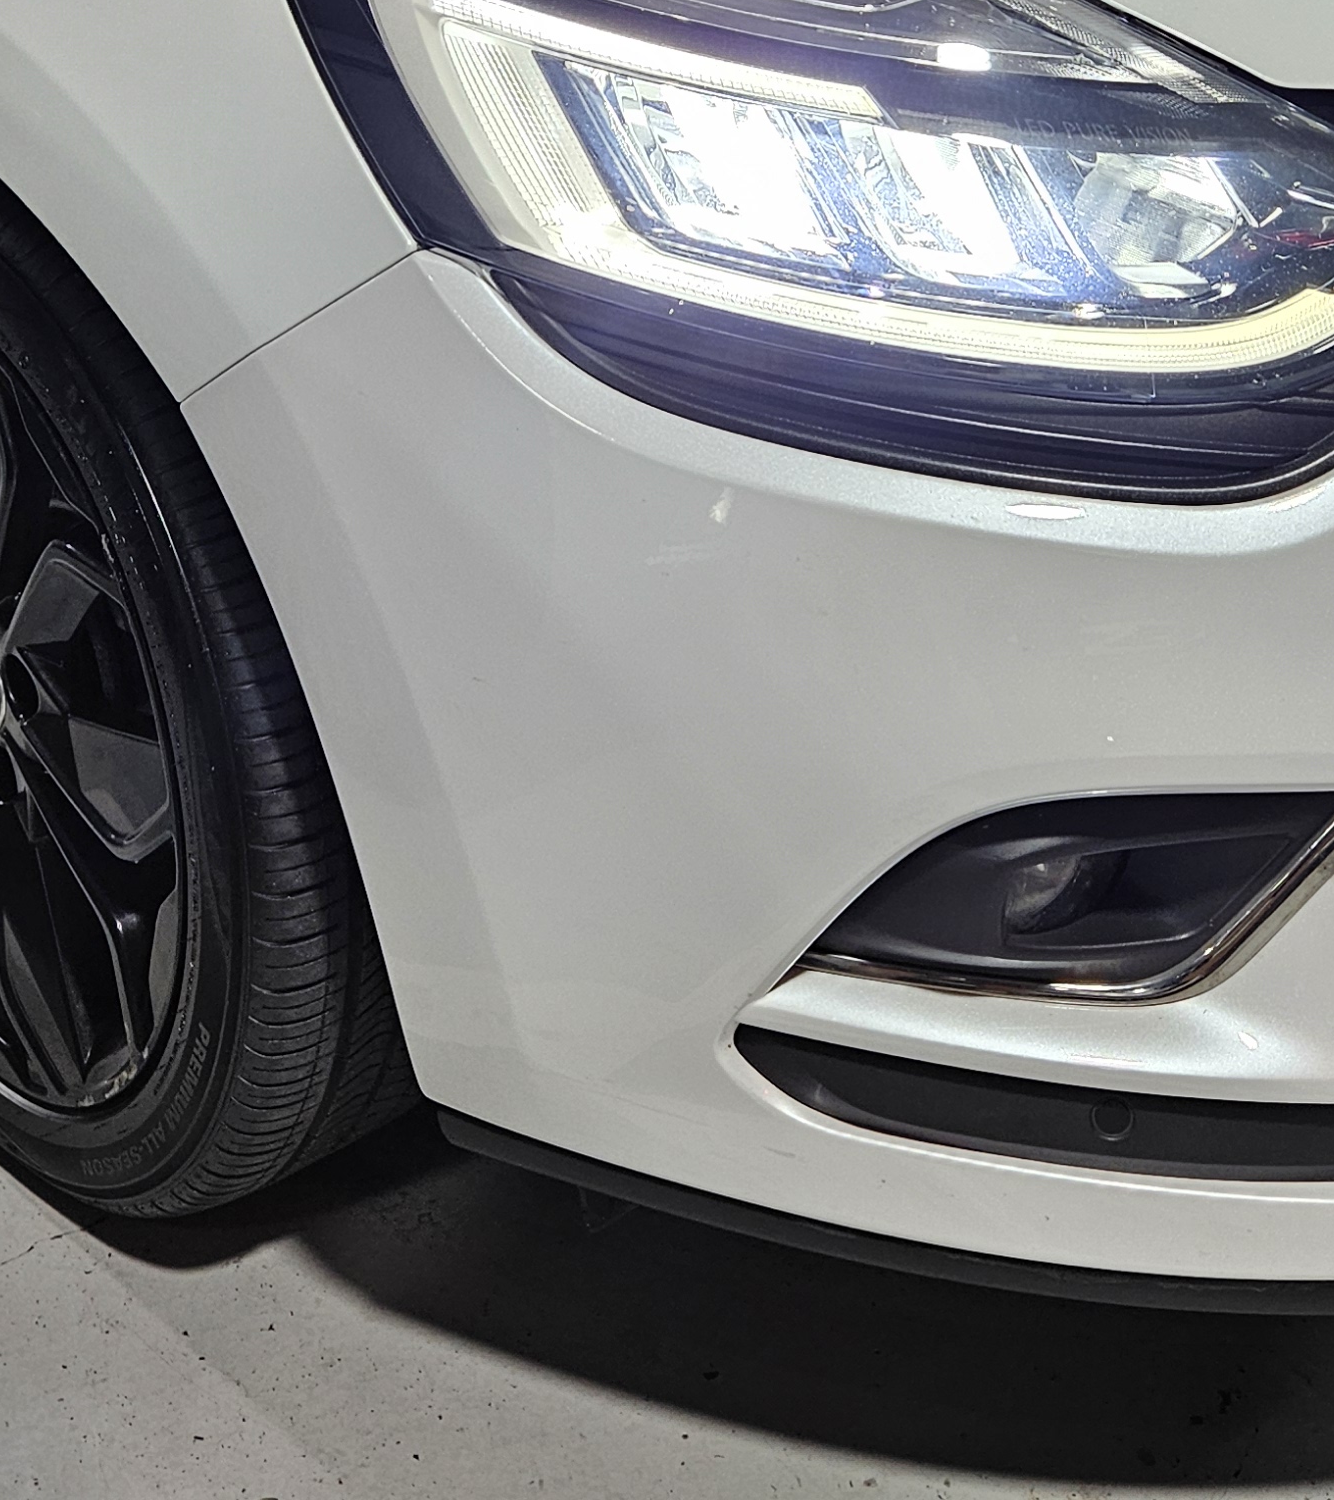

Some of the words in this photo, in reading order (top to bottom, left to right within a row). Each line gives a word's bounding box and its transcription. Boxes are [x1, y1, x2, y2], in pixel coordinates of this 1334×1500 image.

[1014, 117, 1056, 138] LED
[1062, 121, 1117, 142] PURE
[1124, 124, 1194, 146] VISION
[163, 1020, 211, 1132] PREMIUM
[80, 1120, 167, 1177] ALL-SEASON
